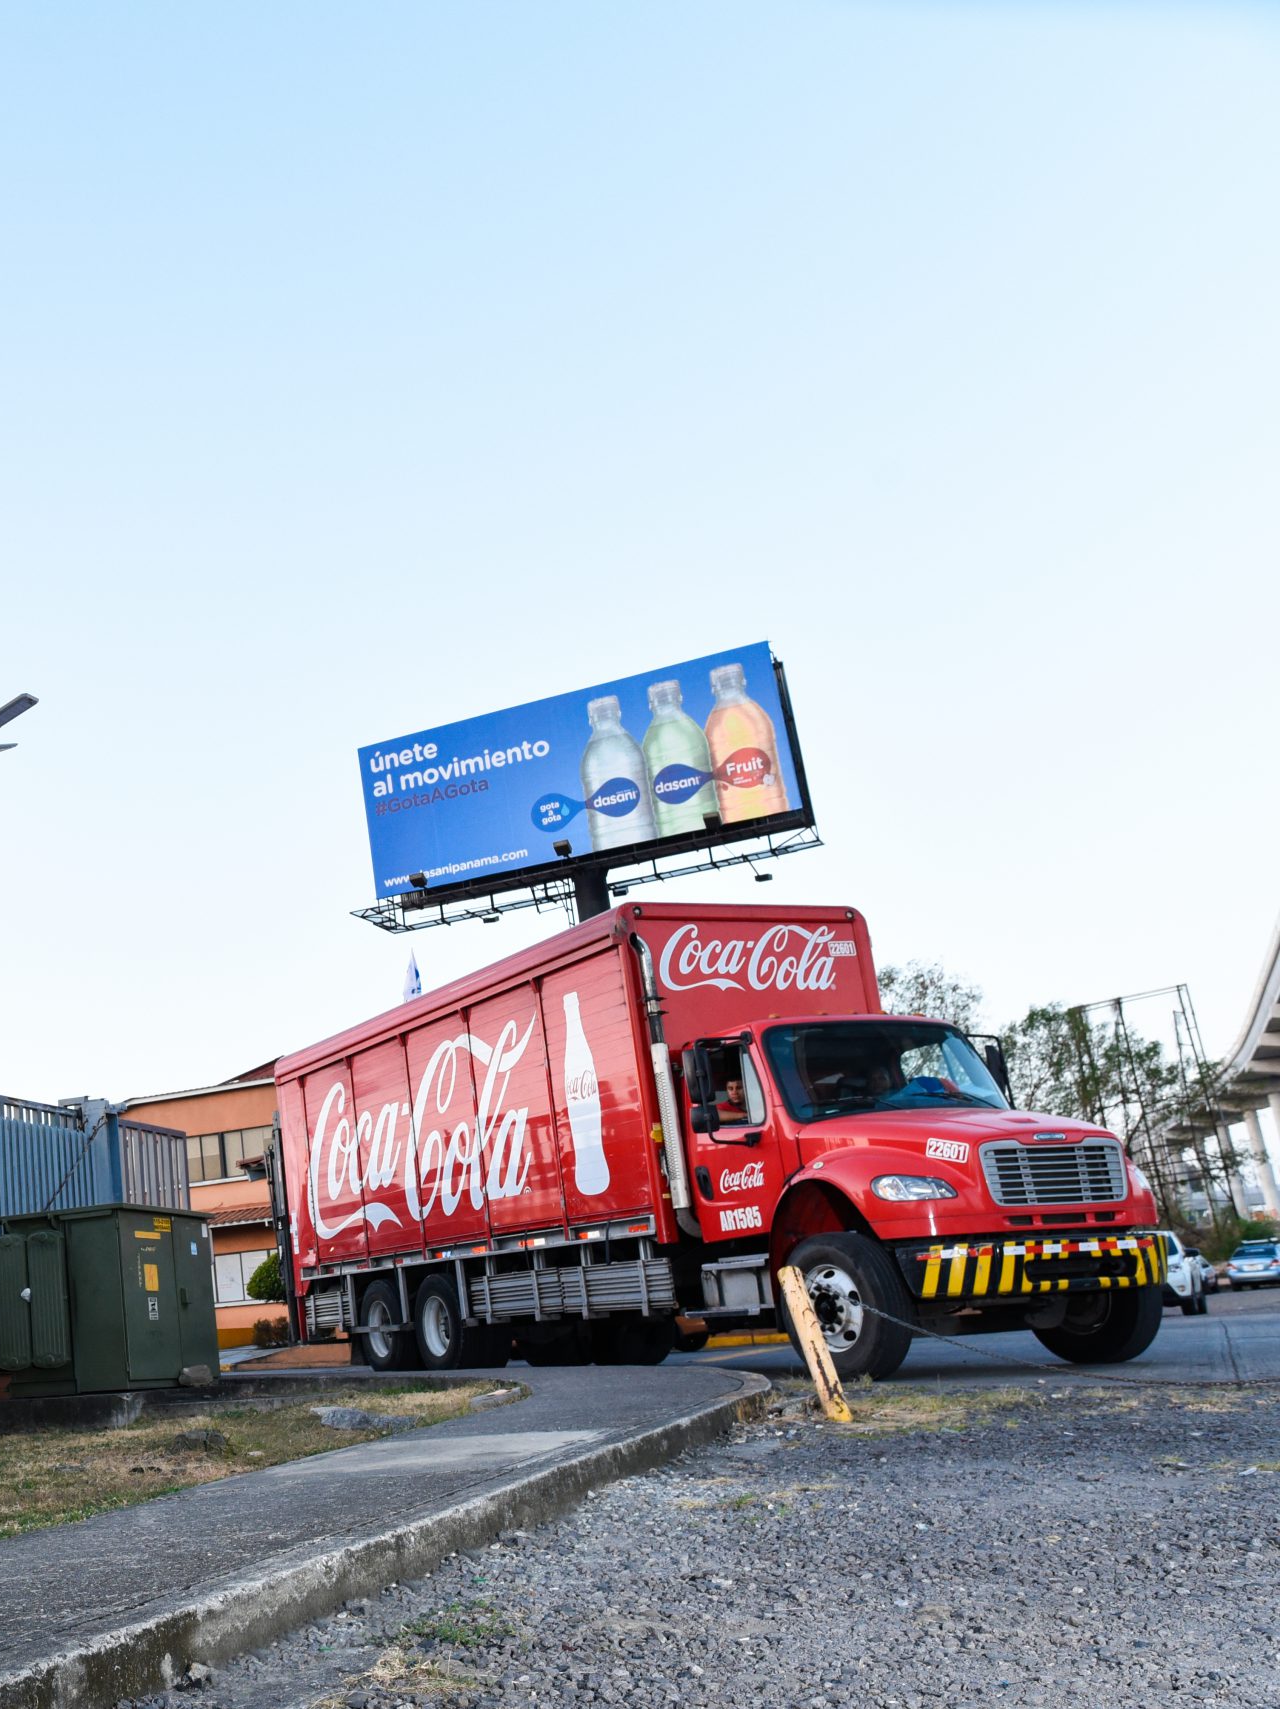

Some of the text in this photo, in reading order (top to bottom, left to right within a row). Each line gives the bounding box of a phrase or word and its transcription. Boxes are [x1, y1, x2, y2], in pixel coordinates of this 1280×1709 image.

[370, 742, 438, 773] únete
[373, 740, 550, 797] al movimiento
[726, 756, 764, 776] Fruit
[375, 779, 489, 816] #GotaAGota
[593, 789, 637, 808] dasani
[655, 776, 700, 794] dasani
[540, 801, 560, 812] gota
[541, 814, 562, 826] gota
[384, 848, 528, 888] wwwasanipanama.com
[659, 923, 836, 992] Coca-Cola
[829, 941, 855, 956] 22601
[307, 1012, 537, 1240] Coca-Cola
[928, 1140, 966, 1161] 22601
[720, 1161, 765, 1194] Coca-Cola
[720, 1205, 763, 1232] AR1585
